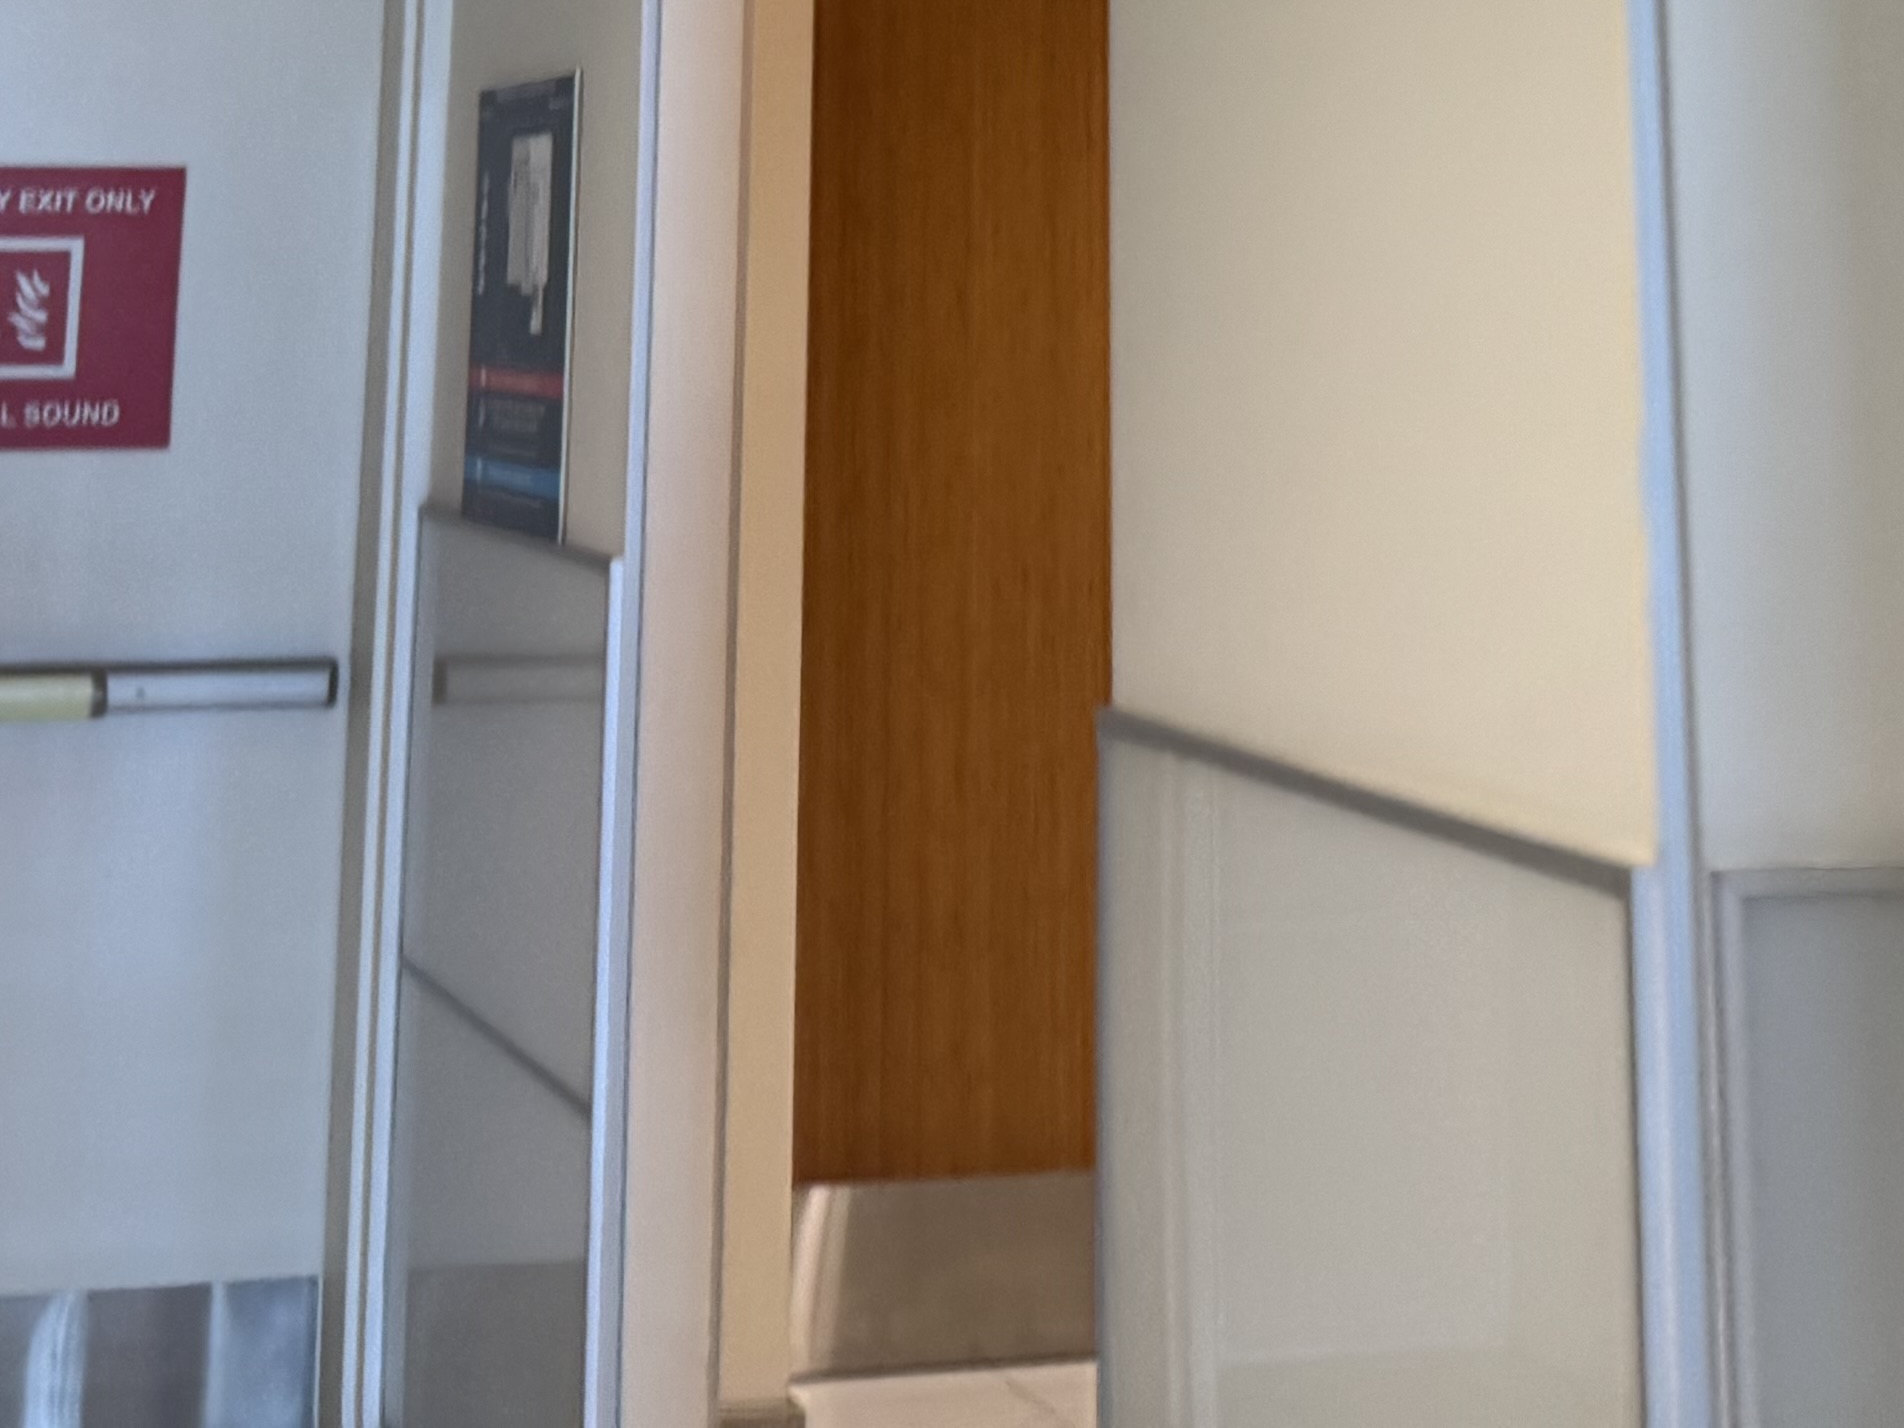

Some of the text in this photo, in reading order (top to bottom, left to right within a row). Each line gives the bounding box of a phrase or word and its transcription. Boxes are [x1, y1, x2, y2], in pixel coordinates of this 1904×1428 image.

[18, 188, 78, 215] EXIT
[84, 188, 156, 216] ONLY
[23, 398, 121, 428] SOUND
